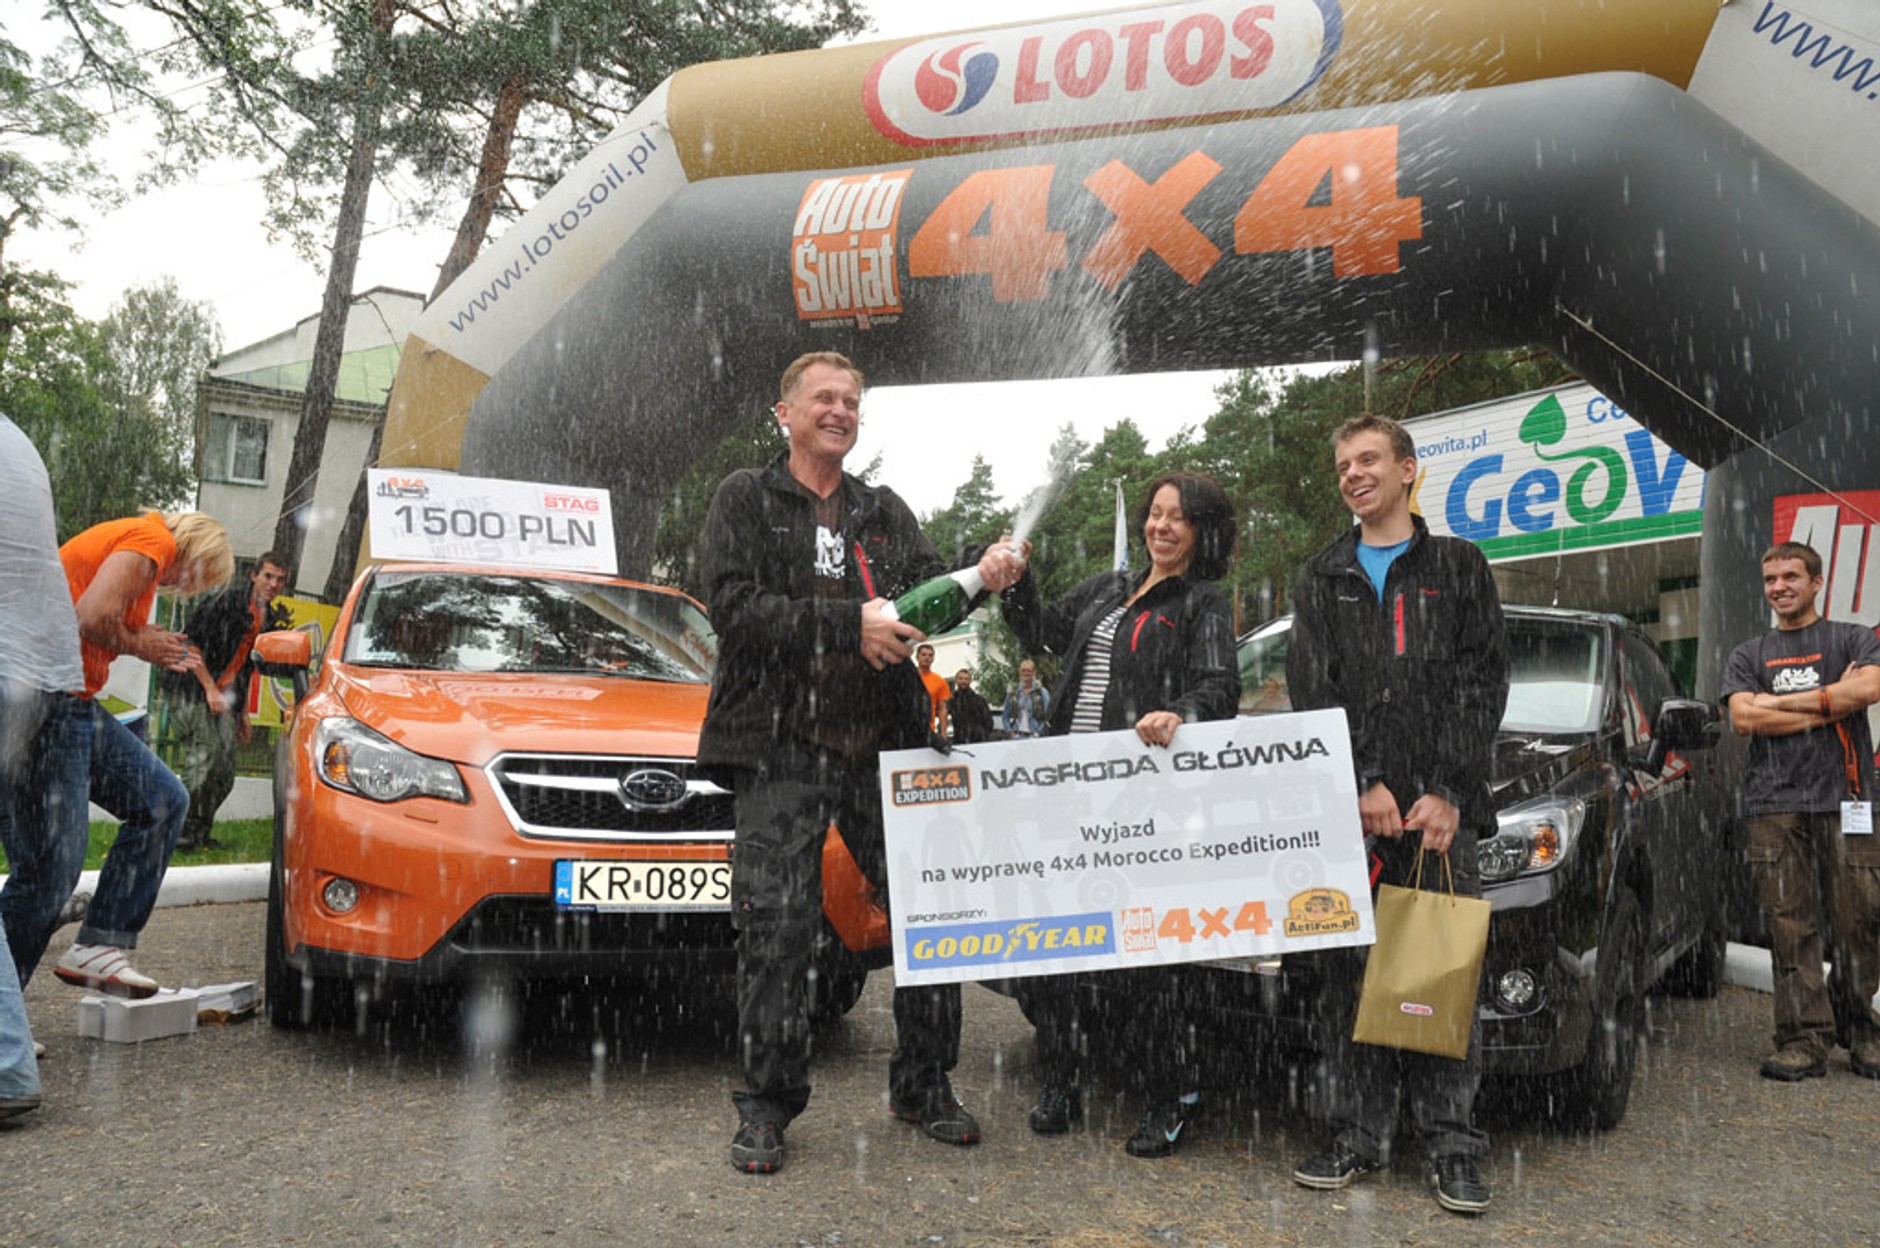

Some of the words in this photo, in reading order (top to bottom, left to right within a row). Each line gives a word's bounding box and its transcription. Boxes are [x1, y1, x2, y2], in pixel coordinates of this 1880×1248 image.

[1013, 5, 1276, 105] LOTOS
[793, 173, 907, 237] Auto
[449, 131, 657, 333] www.lotosoil.pl
[795, 233, 899, 312] Świat
[1412, 428, 1487, 459] eovita.pl
[394, 505, 505, 540] 1500
[519, 514, 596, 547] PLN
[544, 495, 599, 512] STAG
[981, 754, 1160, 791] NAGRODA
[1172, 737, 1330, 772] GŁÓWNA
[895, 786, 969, 803] EXPEDITION
[1080, 818, 1156, 844] Wyjazd
[921, 868, 946, 883] na
[952, 861, 1045, 884] wyprawę
[1050, 853, 1088, 872] 4x4
[1093, 847, 1183, 869] Morocco
[1189, 830, 1321, 861] Expedition!!!
[1157, 900, 1273, 944] 4x4
